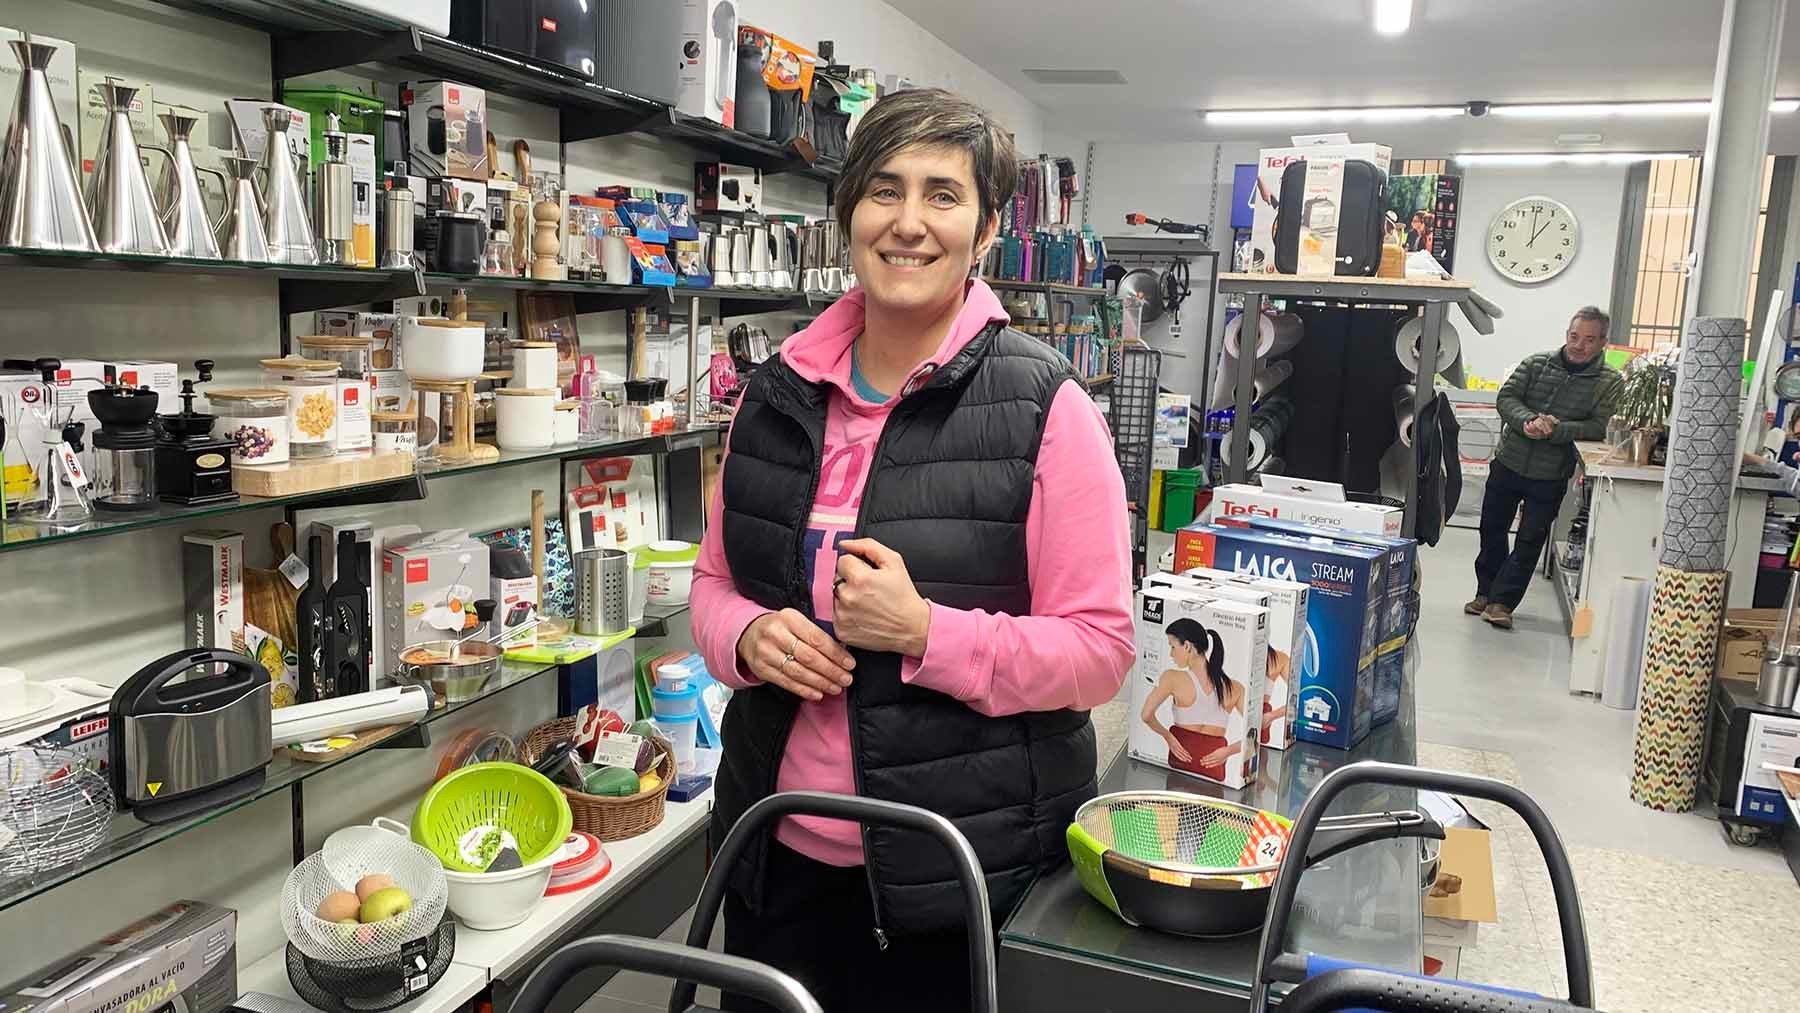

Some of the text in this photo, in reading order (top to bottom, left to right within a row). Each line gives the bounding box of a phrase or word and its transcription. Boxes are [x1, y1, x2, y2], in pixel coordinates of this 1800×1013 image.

[1264, 155, 1305, 168] Tefl
[1551, 209, 1555, 217] 1
[1503, 220, 1516, 229] 10
[1560, 223, 1567, 231] 2
[1496, 234, 1504, 242] 9
[1562, 238, 1570, 246] 3
[1498, 250, 1506, 258] 8
[1554, 253, 1563, 261] 4
[1523, 267, 1532, 275] 6
[1541, 264, 1549, 272] 5
[1234, 550, 1297, 582] LAICA
[221, 544, 229, 606] WESTMARK
[1311, 562, 1354, 583] STREAM
[1262, 842, 1277, 858] 24
[90, 961, 185, 1013] NVASADORA AL VACÍO
